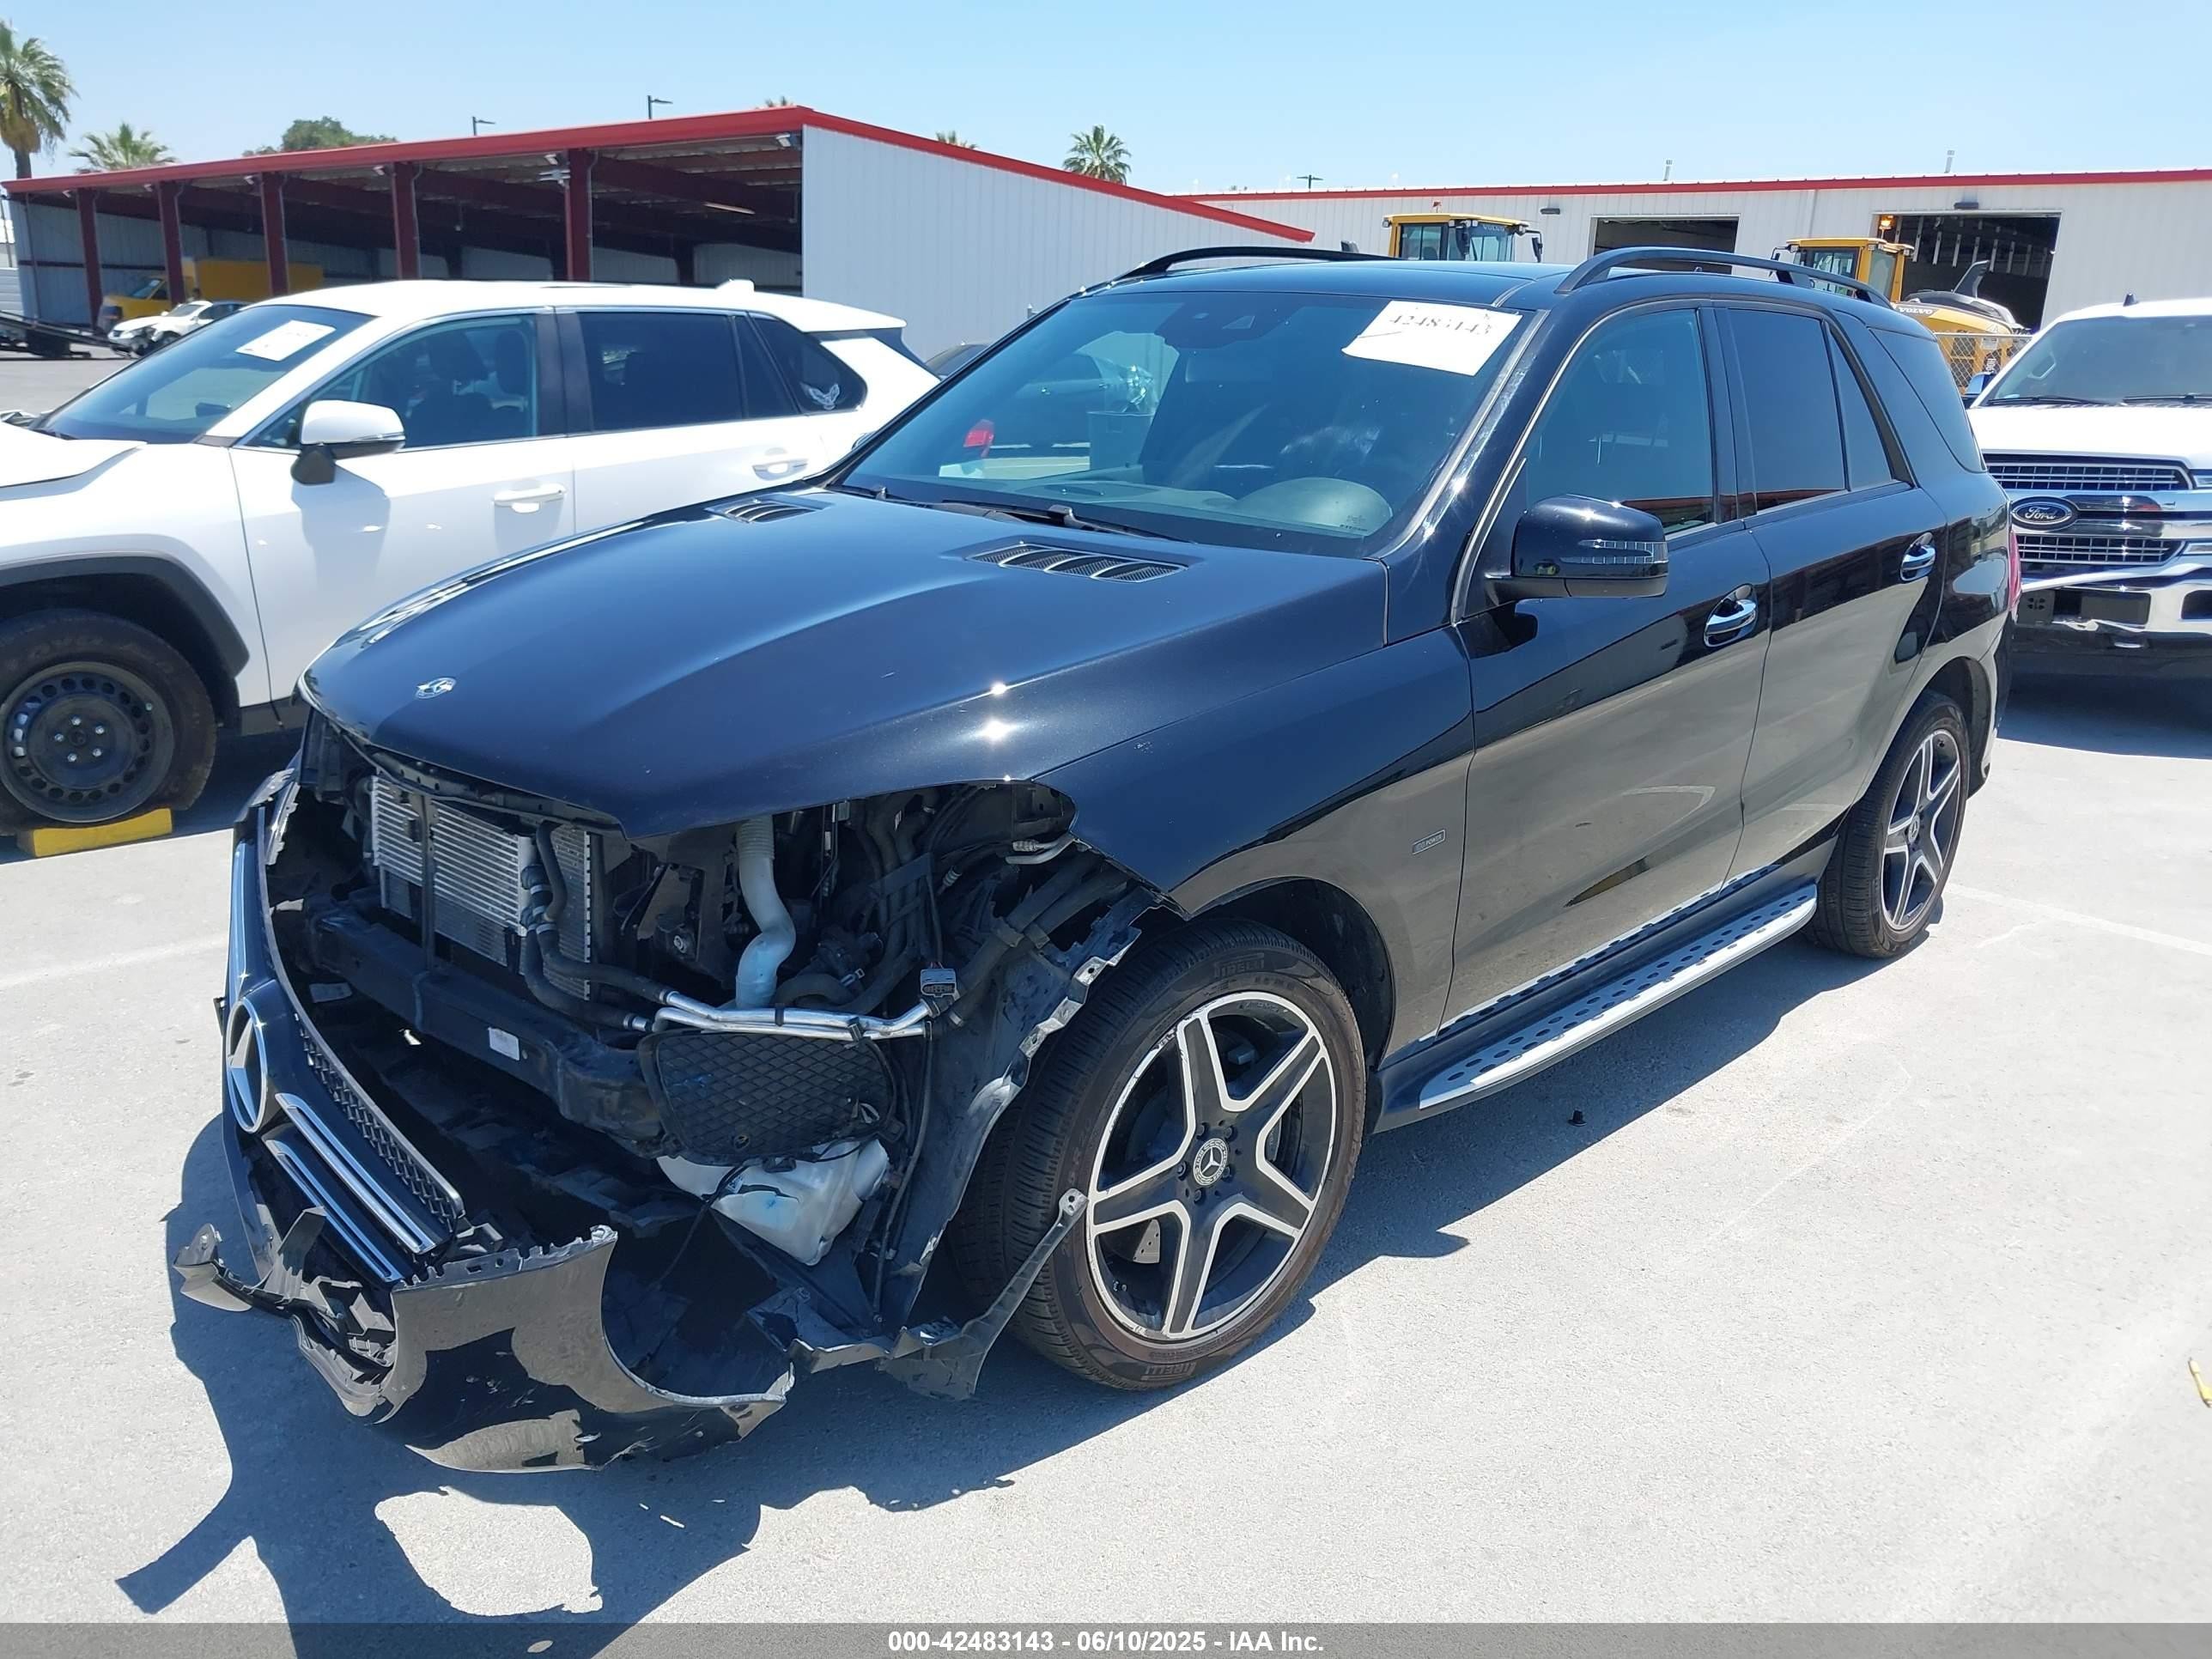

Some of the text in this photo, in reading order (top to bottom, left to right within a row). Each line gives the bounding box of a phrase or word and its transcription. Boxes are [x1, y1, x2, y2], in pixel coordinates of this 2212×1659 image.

[1899, 307, 1933, 315] VOLVO
[2025, 506, 2058, 520] Ford
[1212, 952, 1265, 978] PIRELLI
[1140, 1360, 1197, 1381] PIRELLI
